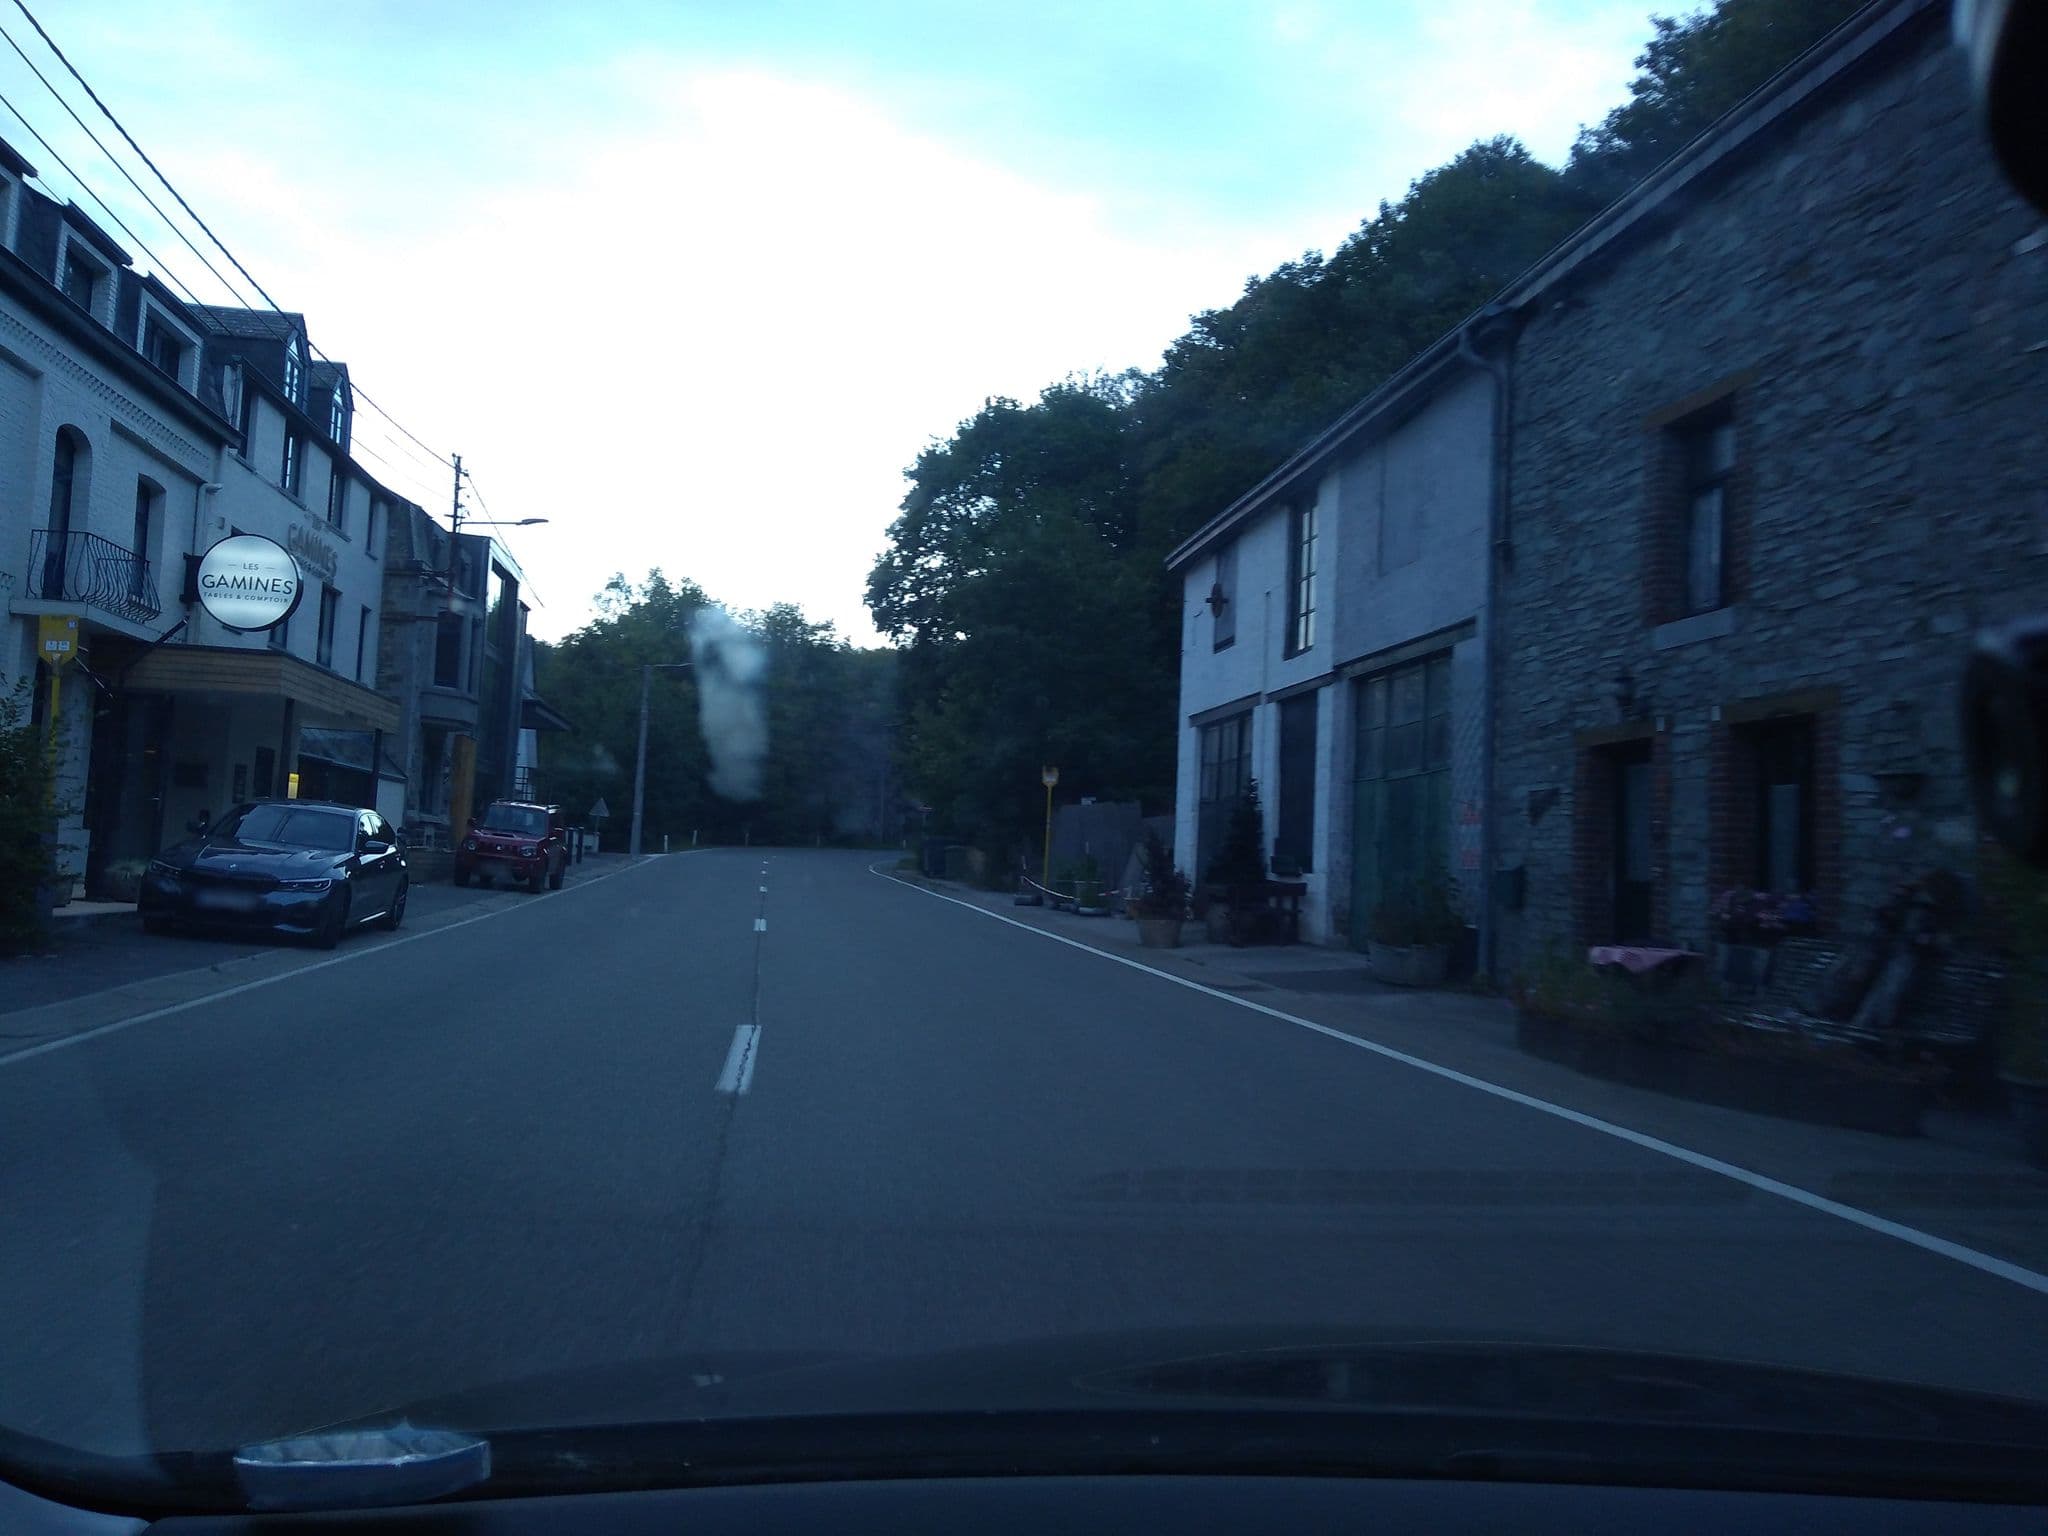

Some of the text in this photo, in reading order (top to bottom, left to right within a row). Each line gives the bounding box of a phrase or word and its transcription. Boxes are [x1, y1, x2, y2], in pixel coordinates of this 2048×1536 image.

[242, 562, 260, 571] LES
[201, 574, 294, 595] GAMINES
[244, 594, 289, 603] COMPTOIR
